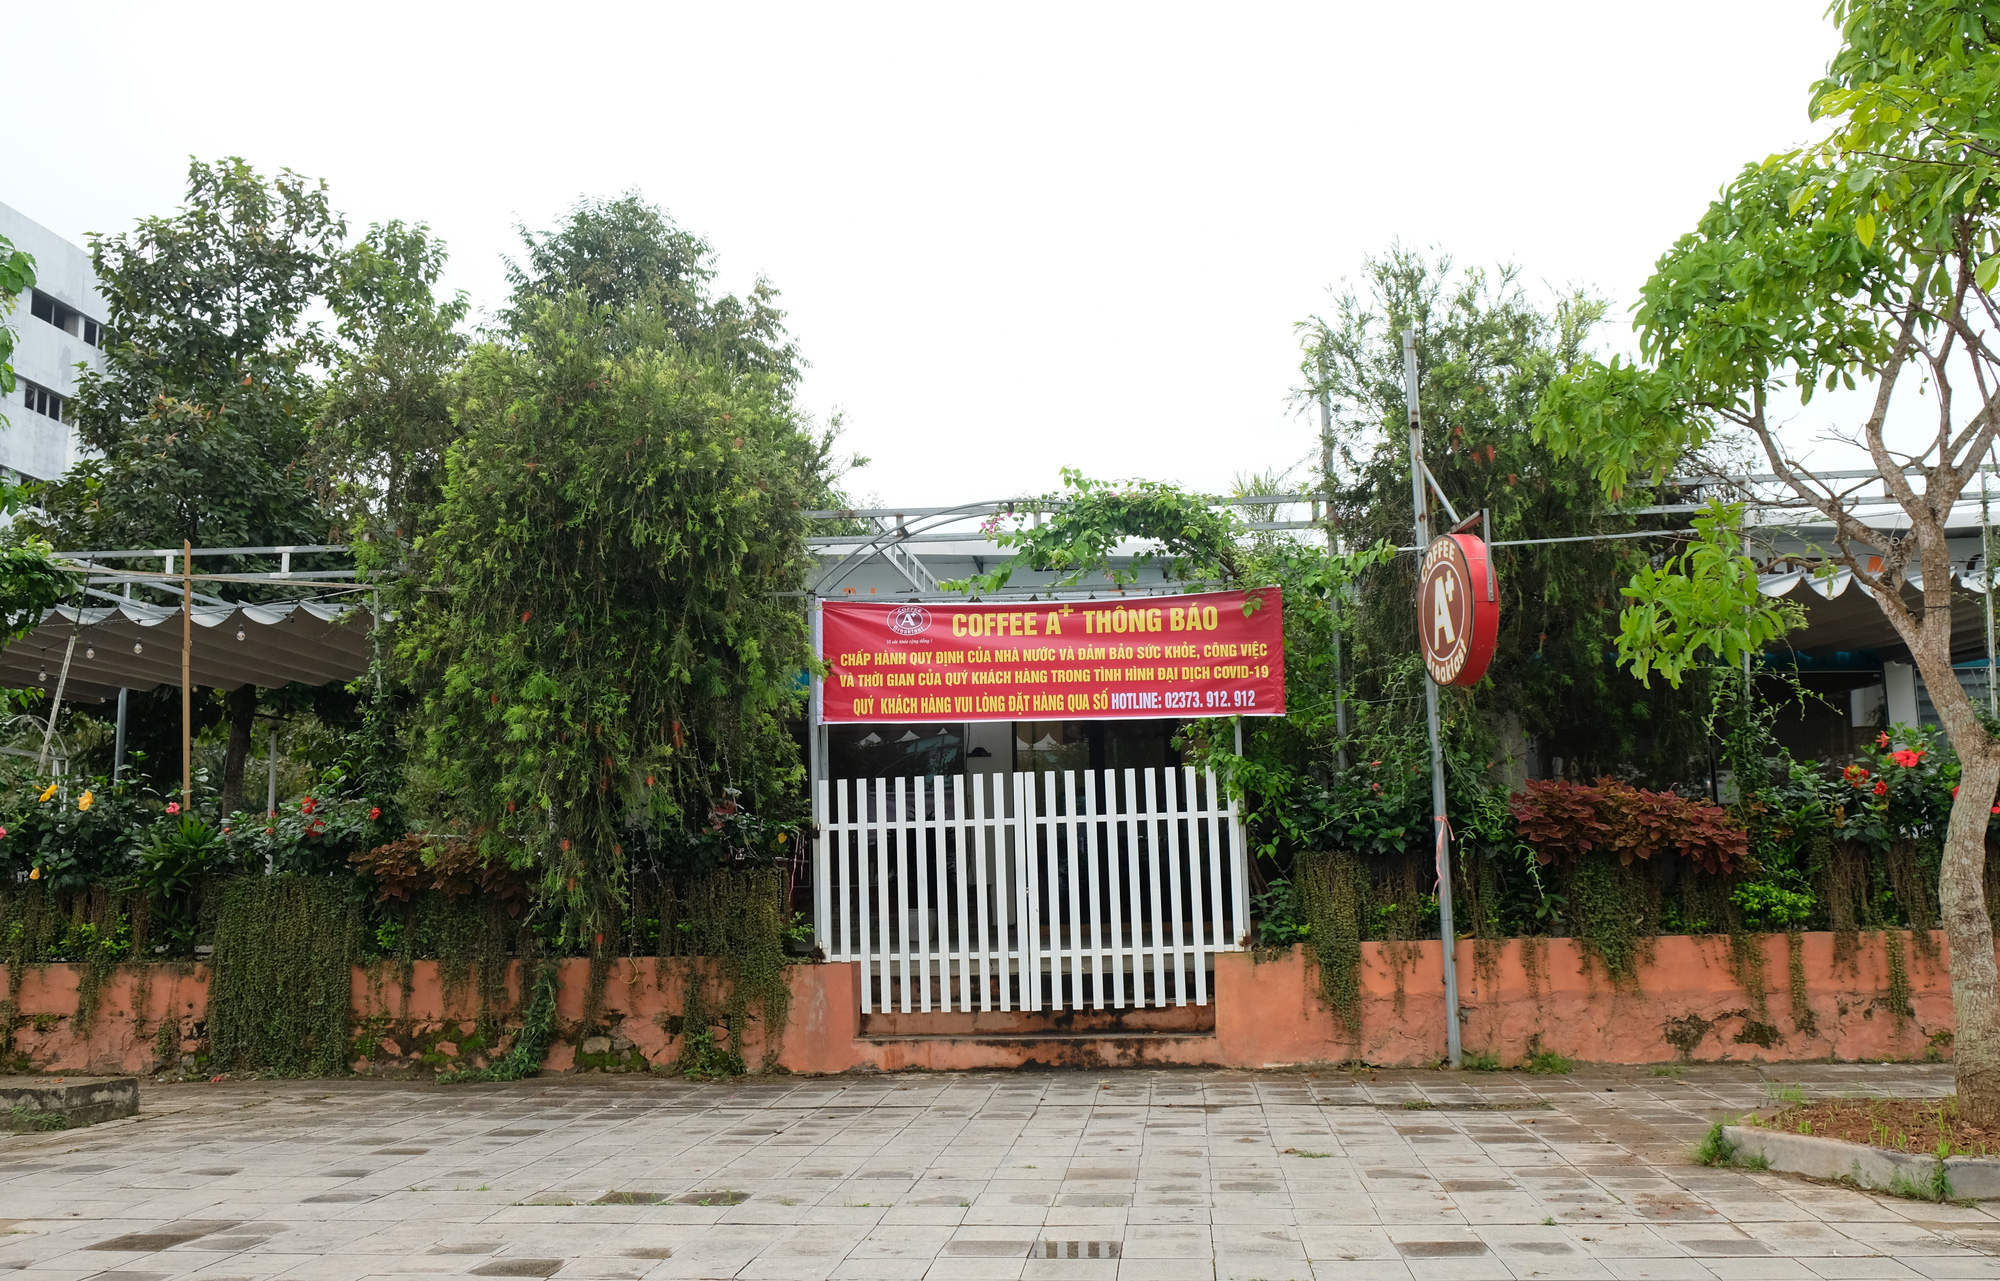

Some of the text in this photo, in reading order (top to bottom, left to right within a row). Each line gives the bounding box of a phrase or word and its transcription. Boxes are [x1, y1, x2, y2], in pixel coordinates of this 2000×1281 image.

[1421, 540, 1455, 583] COFFEE
[893, 625, 924, 634] Breakfast
[953, 613, 1037, 637] COFFEE
[1083, 606, 1161, 633] THÔNG
[1170, 602, 1217, 631] BÁO
[841, 641, 1267, 666] CHẤP HÀNH QUY ĐỊNH CỦA NHÀ NƯỚC VÀ ĐẢM BẢO SỨC KHỎE, CÔNG VIỆC
[1427, 638, 1467, 682] Breakfast
[840, 665, 1268, 687] VÀ THỜI GIAN CỦA QUÝ KHÁCH HÀNG TRONG TÌNH HÌNH ĐẠI DỊCH COVID-19
[854, 688, 1255, 716] QUÝ KHÁCH HÀNG VUI LÒNG ĐẶT HÀNG QUA SỐ HOTLINE: 02373. 912. 912
